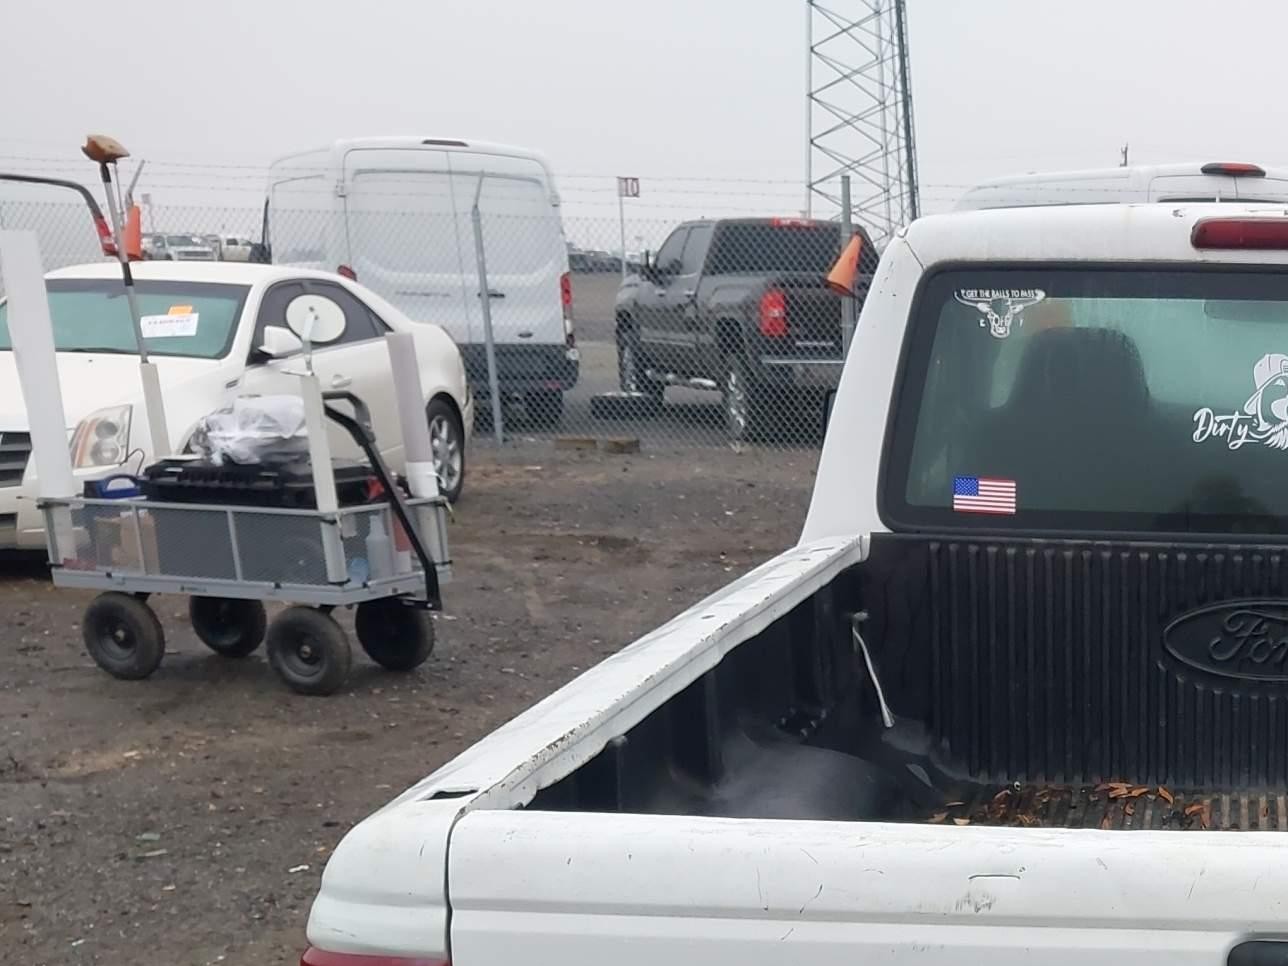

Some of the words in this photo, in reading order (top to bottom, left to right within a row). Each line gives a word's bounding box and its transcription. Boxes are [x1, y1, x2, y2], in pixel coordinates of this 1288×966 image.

[991, 289, 1010, 298] BALLS
[1011, 289, 1020, 298] TO
[1020, 289, 1035, 298] PASS
[1193, 408, 1259, 450] Dirty
